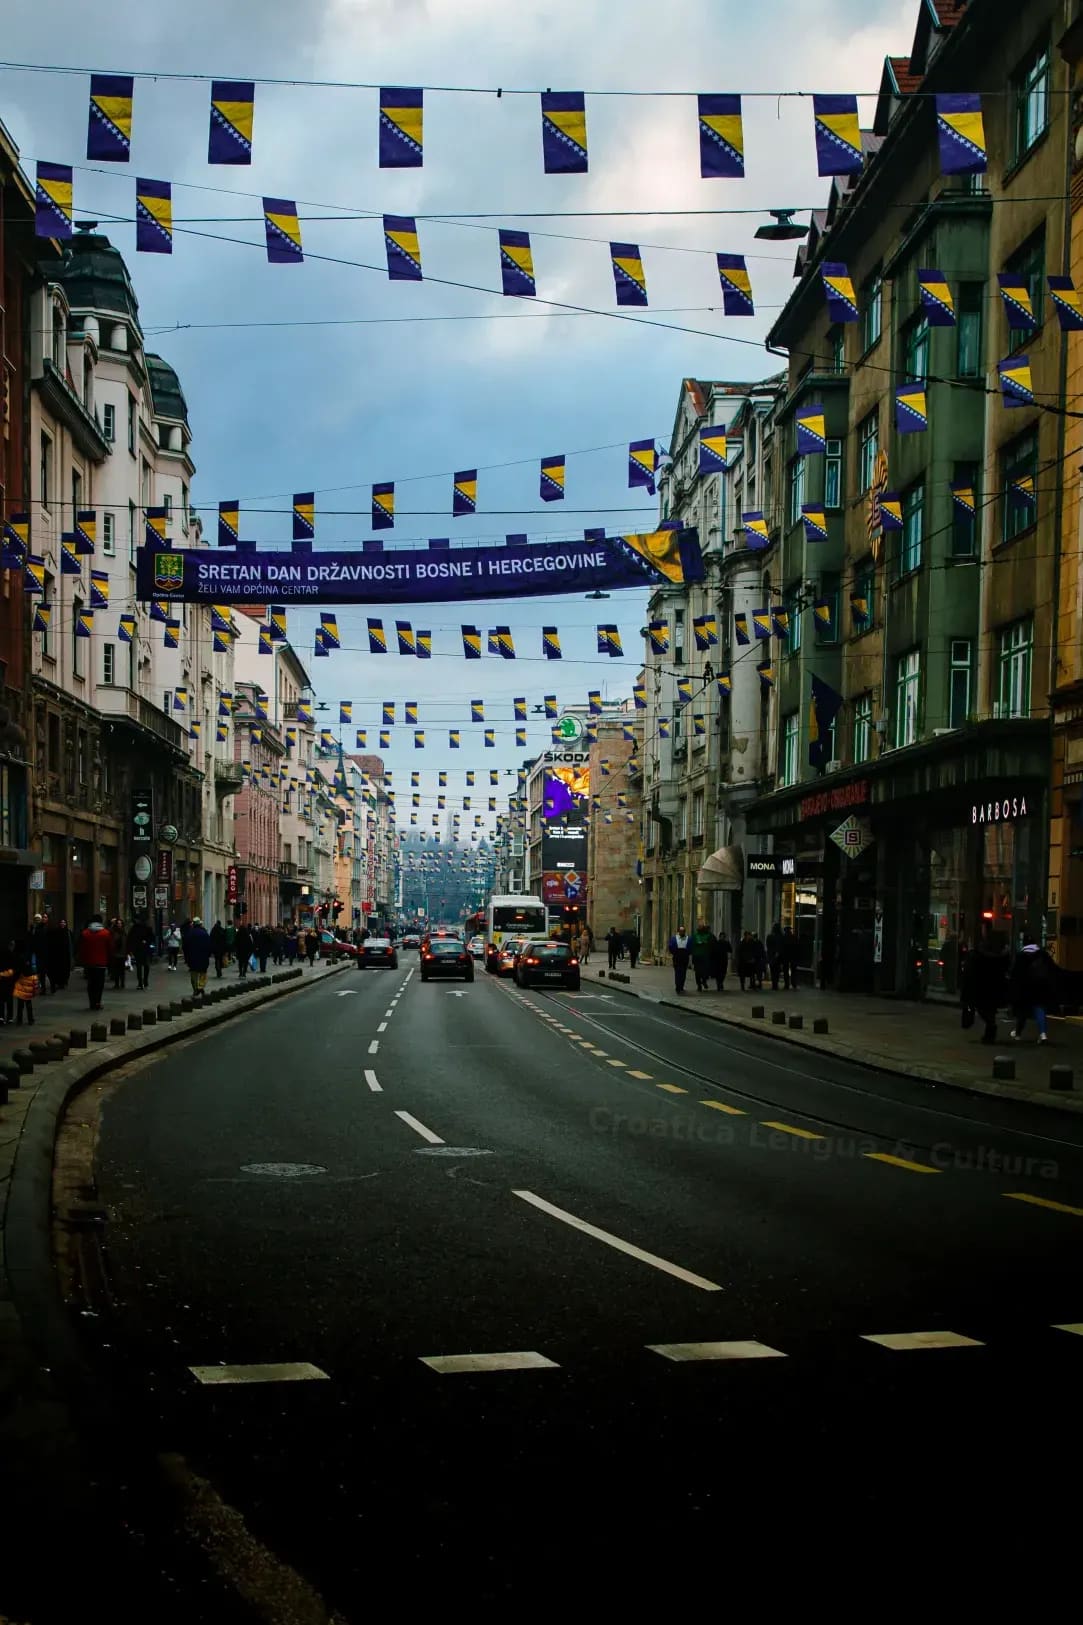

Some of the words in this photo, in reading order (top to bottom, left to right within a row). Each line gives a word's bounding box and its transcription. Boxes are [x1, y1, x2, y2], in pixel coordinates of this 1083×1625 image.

[198, 564, 261, 579] SRETAN
[267, 565, 301, 580] DAN
[307, 562, 409, 581] DRŽAVNOSTI
[416, 562, 472, 578] BOSNE
[478, 562, 482, 575] I
[489, 552, 606, 575] HERCEGOVINE
[198, 582, 217, 593] ŽELI
[220, 585, 240, 594] VAM
[281, 585, 319, 595] CENTAR
[972, 795, 1027, 824] BARBOSA
[750, 862, 775, 871] MONA
